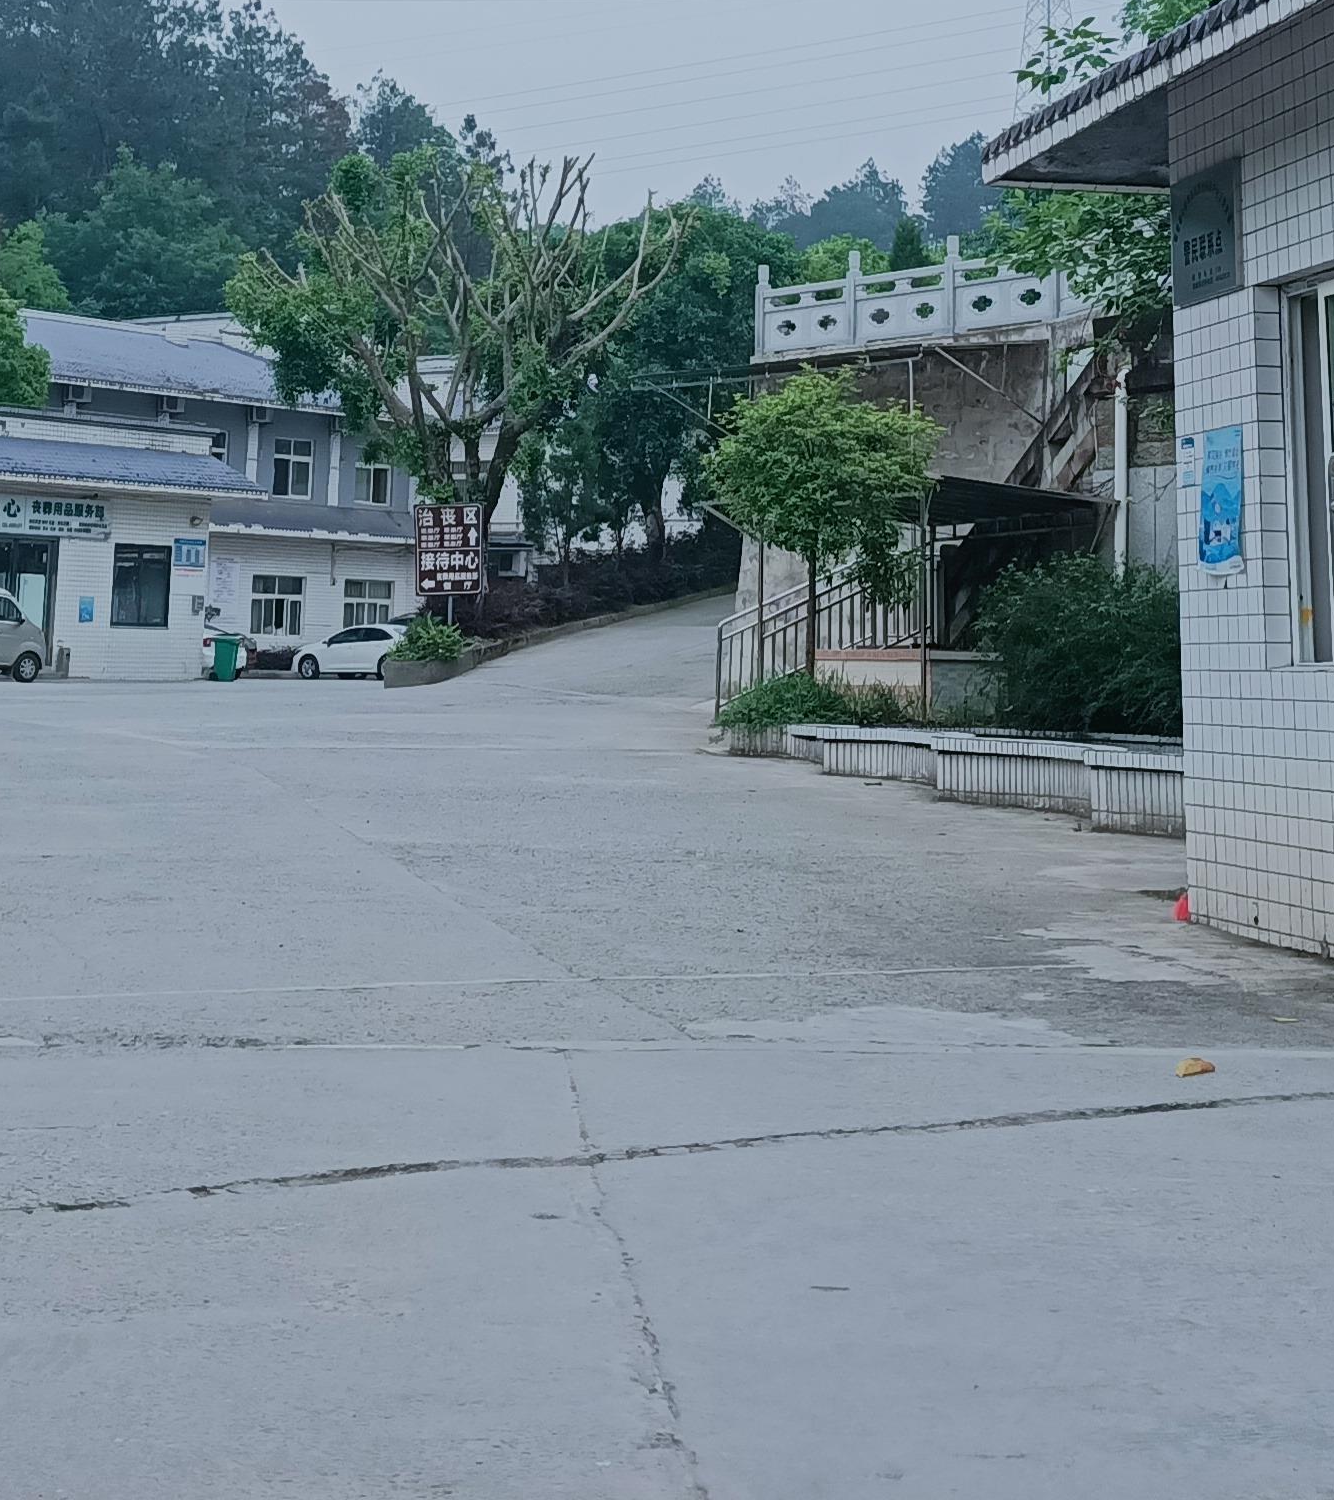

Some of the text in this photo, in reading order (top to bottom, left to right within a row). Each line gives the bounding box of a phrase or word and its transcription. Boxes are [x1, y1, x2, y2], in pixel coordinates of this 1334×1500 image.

[31, 500, 106, 519] 丧葬用品服务部
[418, 507, 478, 526] 治丧区
[420, 551, 479, 571] 接待中心
